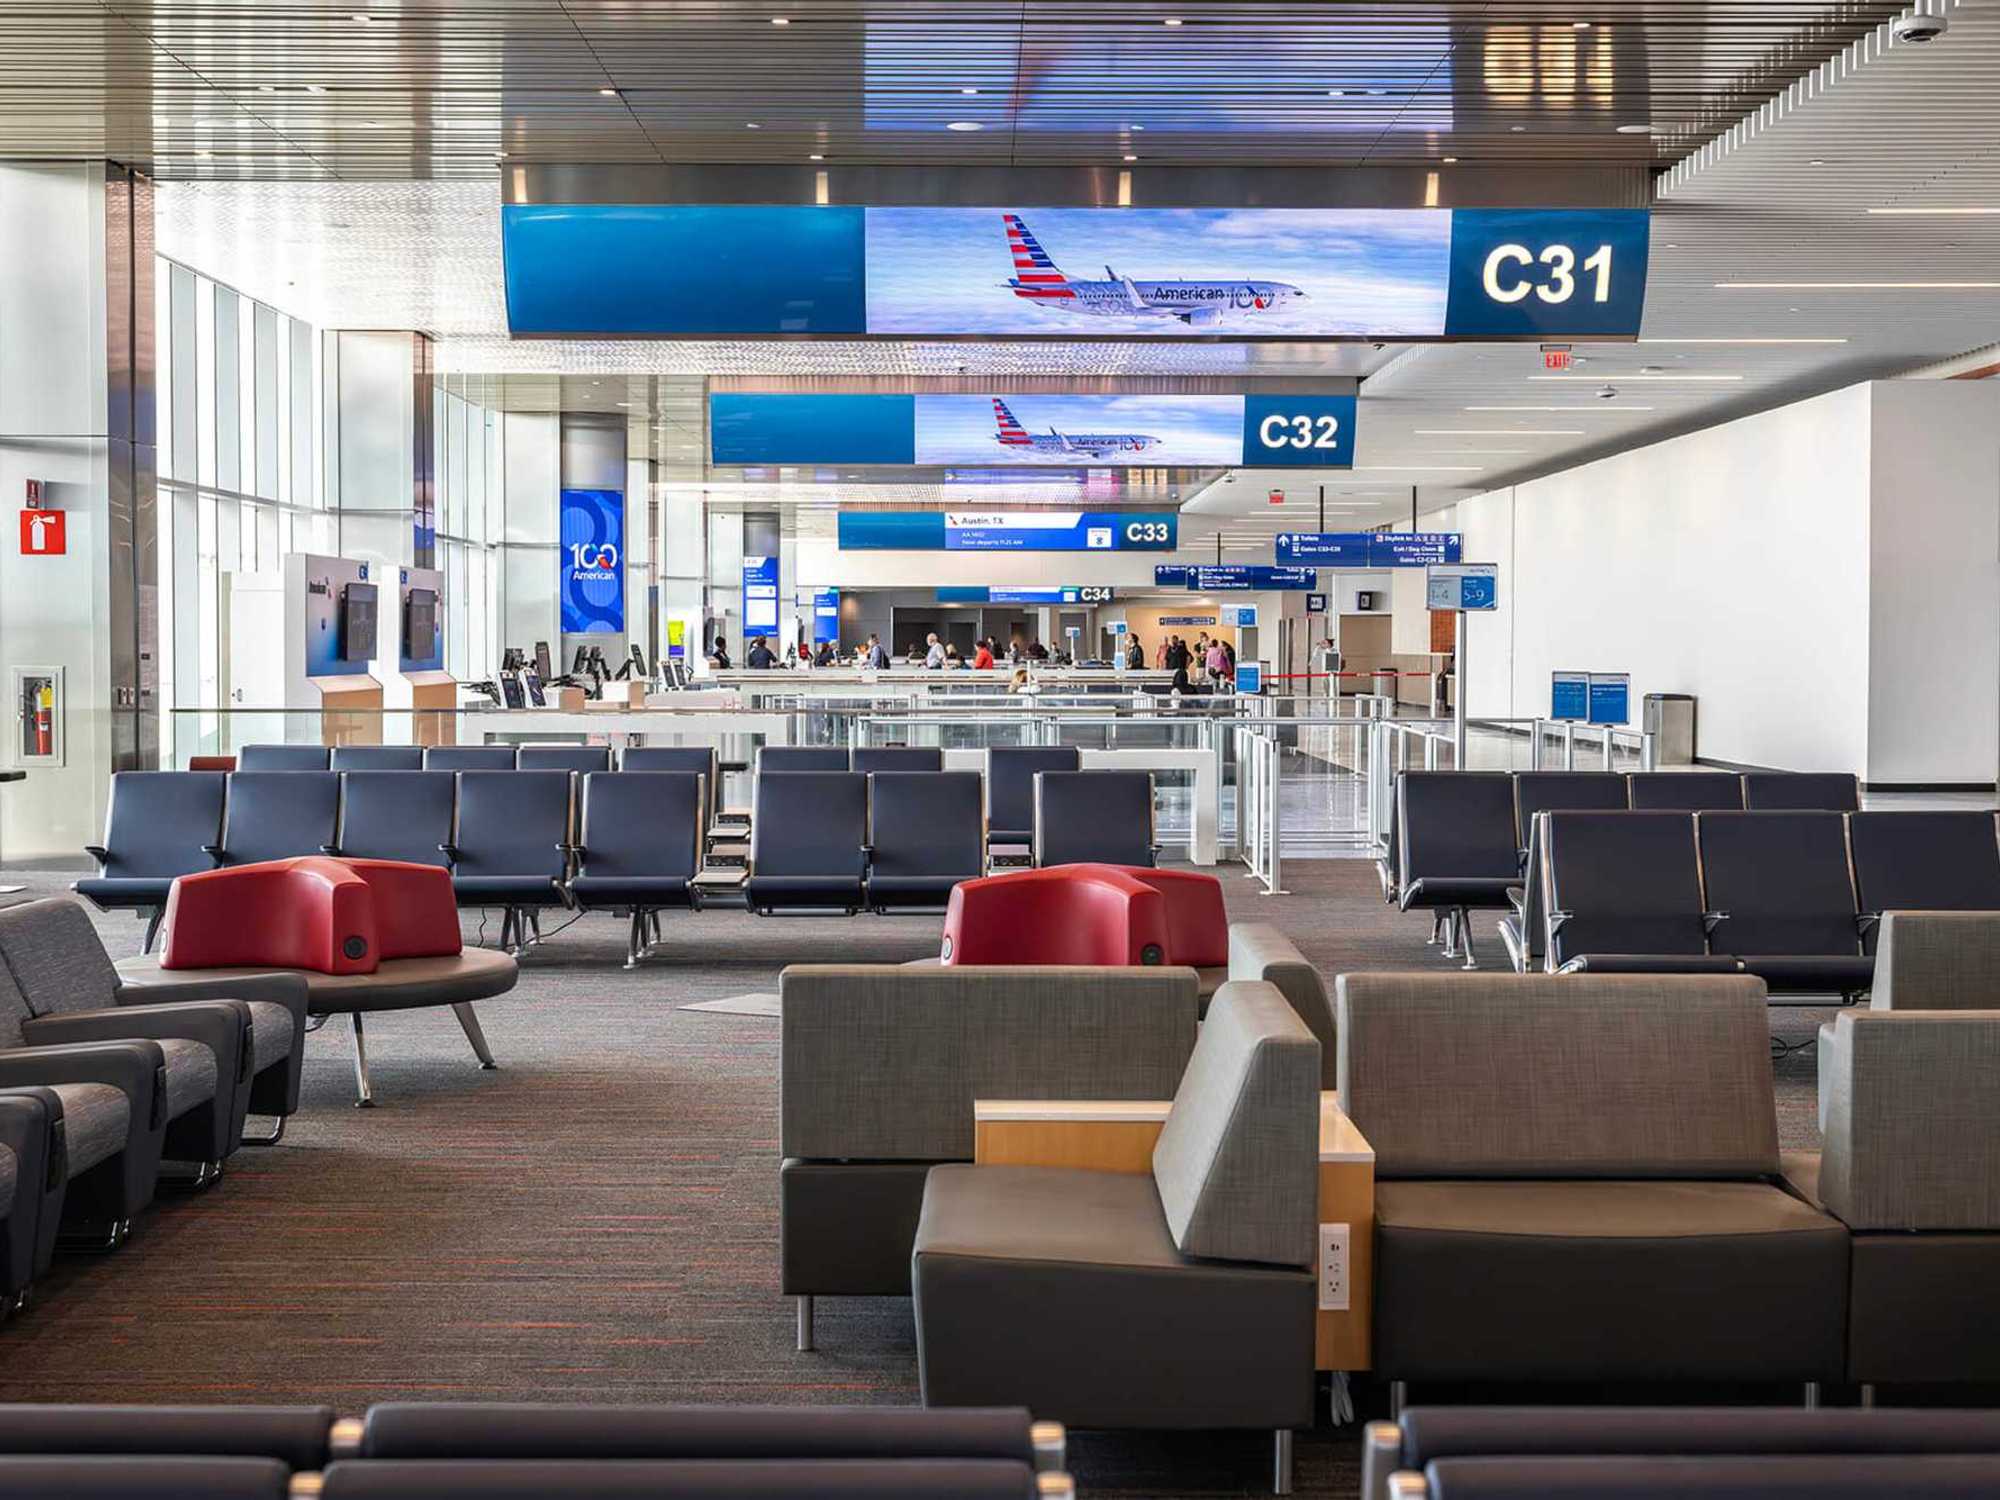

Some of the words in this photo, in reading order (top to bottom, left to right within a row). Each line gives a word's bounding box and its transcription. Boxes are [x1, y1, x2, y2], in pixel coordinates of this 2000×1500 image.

[1483, 244, 1612, 304] C31
[1154, 287, 1224, 300] American
[1260, 415, 1338, 449] C32
[1127, 523, 1168, 541] C33
[570, 544, 617, 570] 100
[573, 571, 615, 580] American
[1081, 588, 1111, 601] C34
